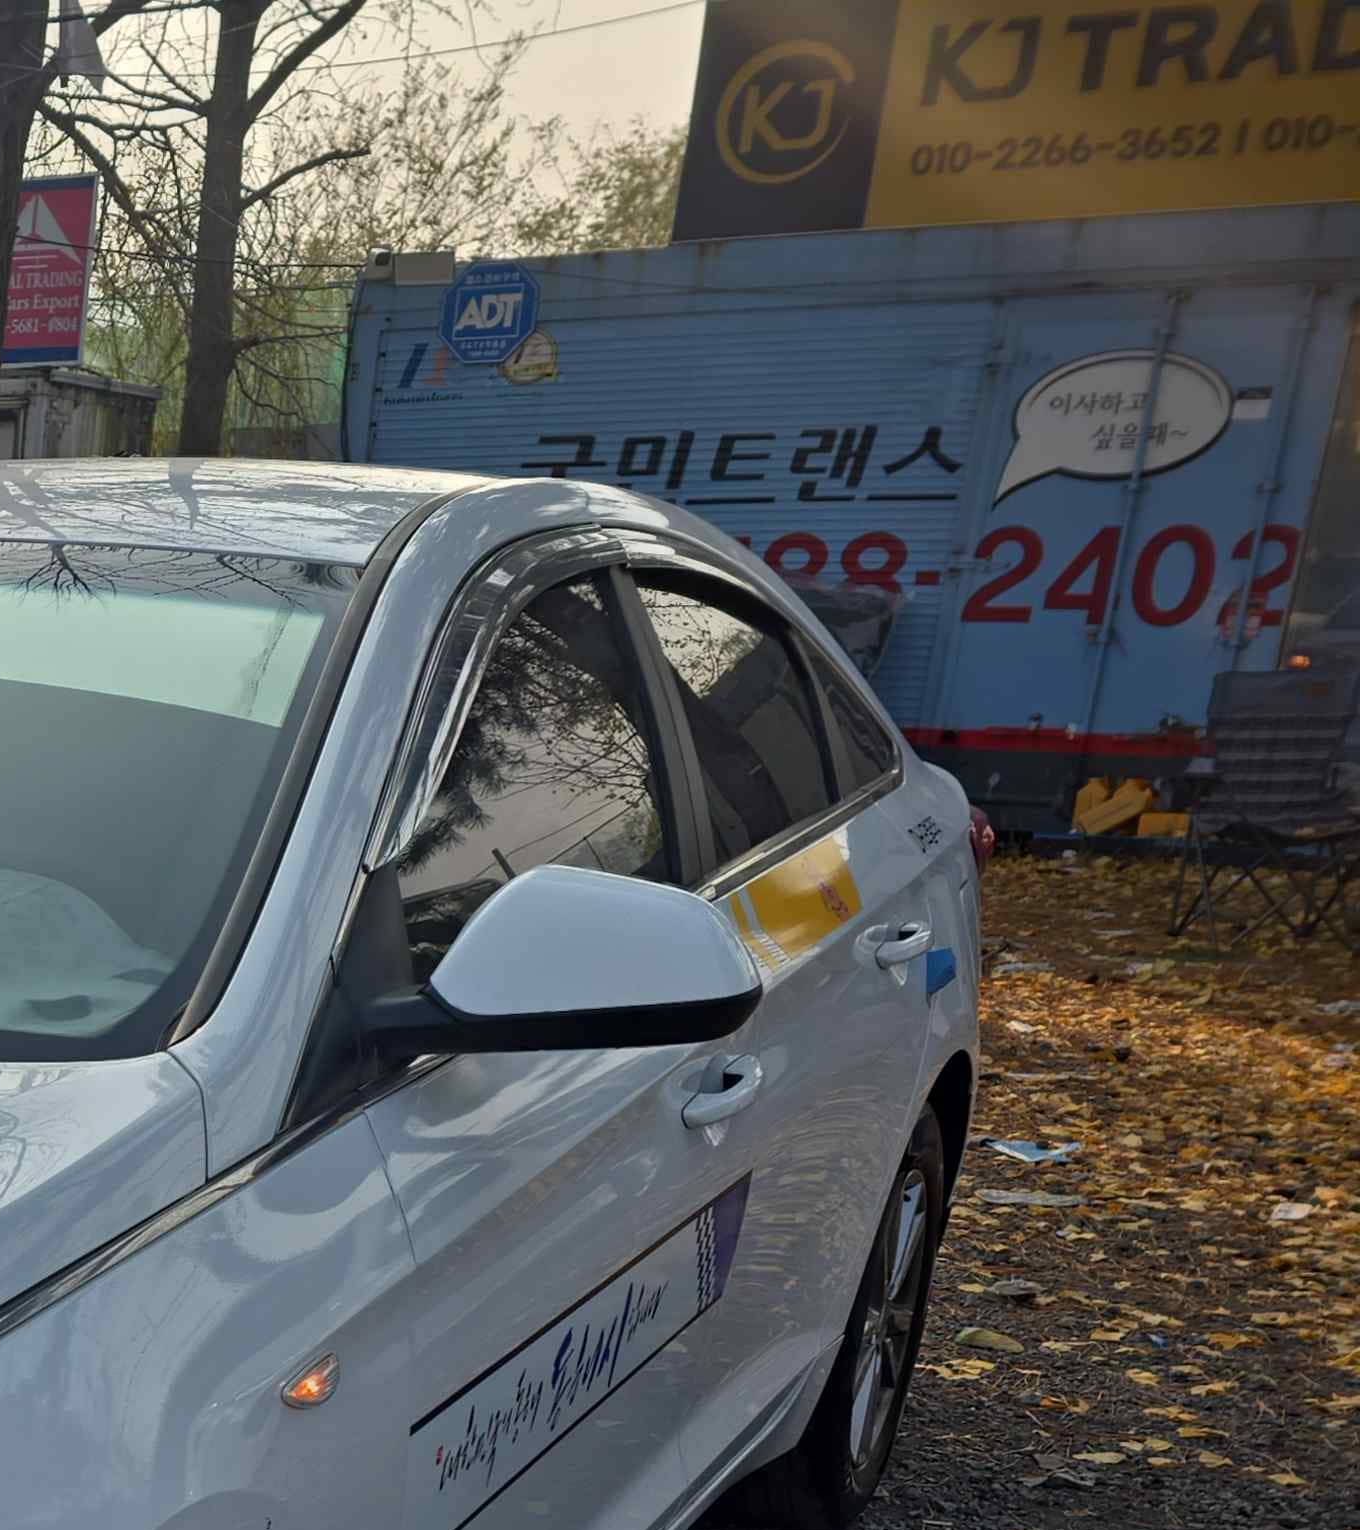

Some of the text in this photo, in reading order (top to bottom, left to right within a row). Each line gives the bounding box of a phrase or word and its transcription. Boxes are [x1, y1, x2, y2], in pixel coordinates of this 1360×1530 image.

[920, 16, 1042, 107] KJ
[739, 79, 837, 154] KJ
[911, 121, 1221, 177] 010-2266-3652
[1263, 113, 1360, 152] 010-
[32, 293, 81, 314] Export
[454, 292, 524, 331] ADT
